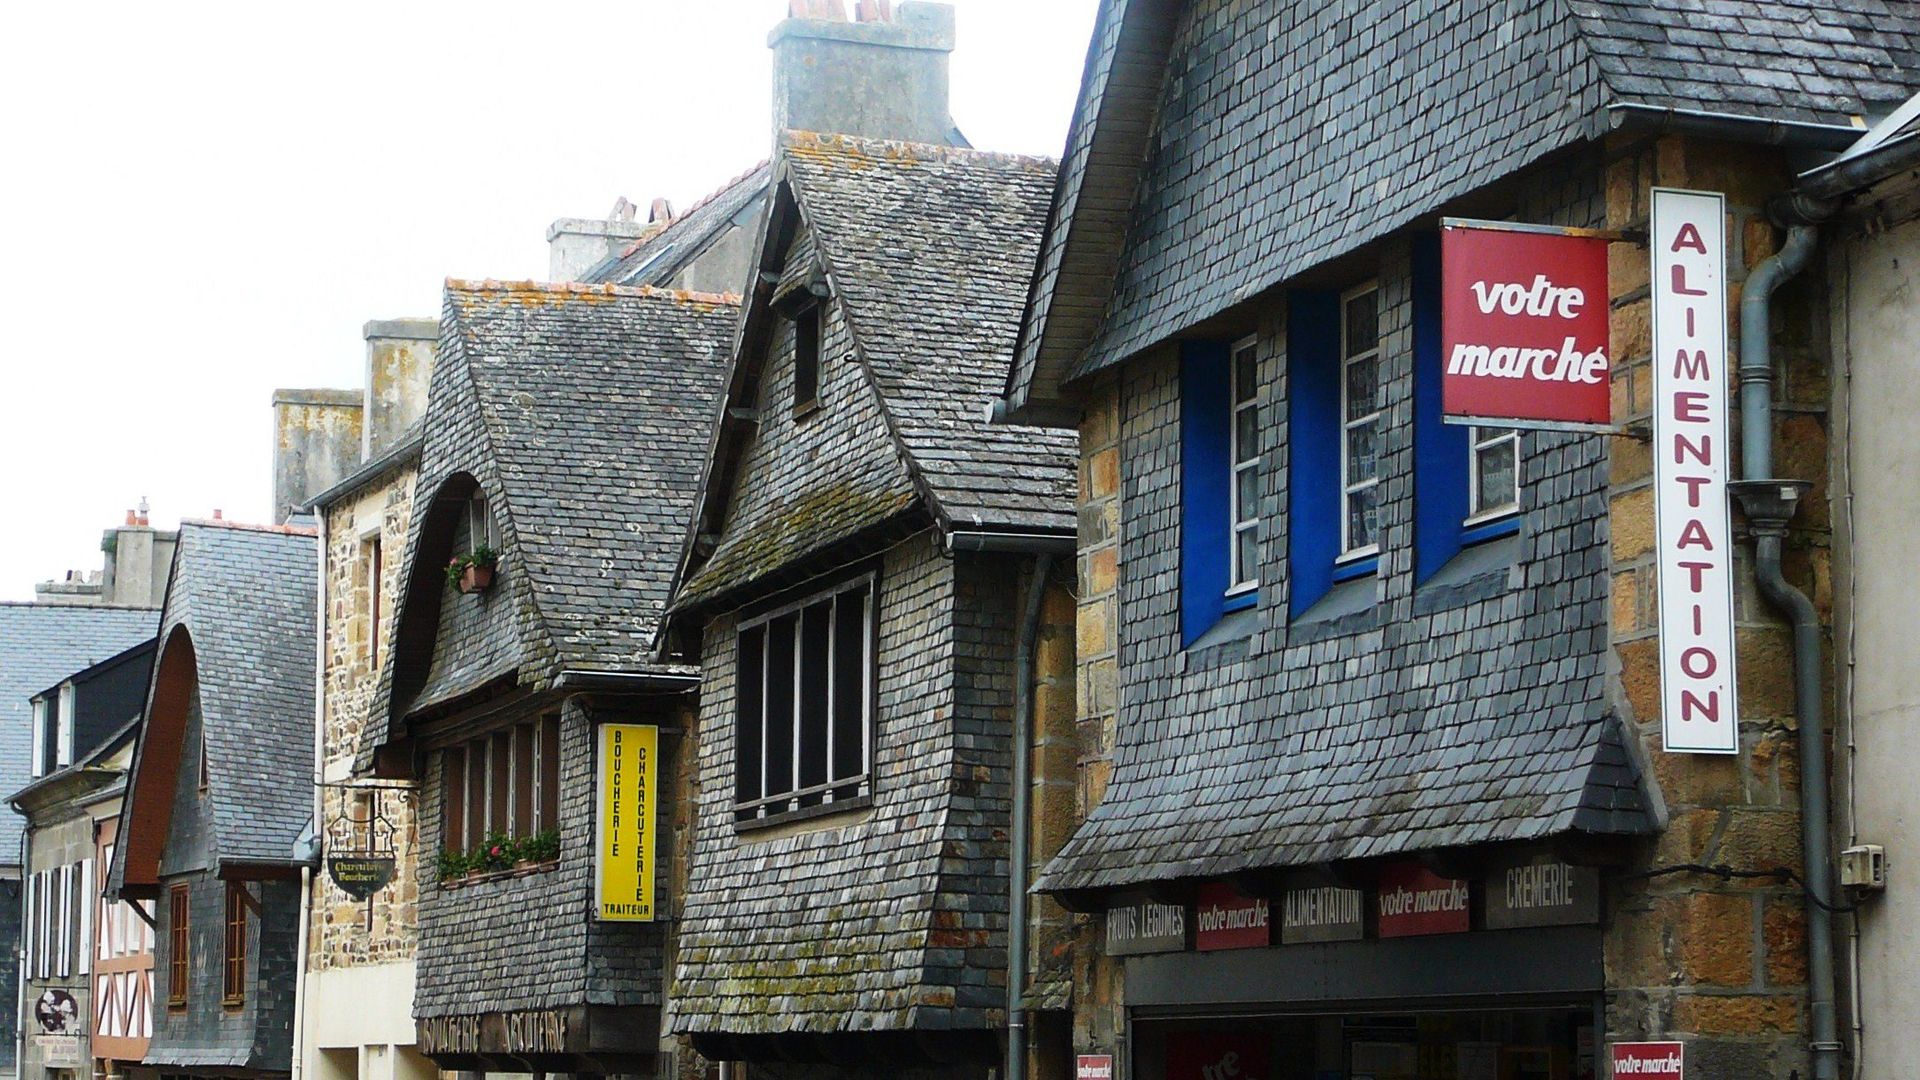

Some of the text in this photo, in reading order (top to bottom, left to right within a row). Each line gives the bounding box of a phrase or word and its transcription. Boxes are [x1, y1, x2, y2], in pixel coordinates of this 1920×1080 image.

[1470, 274, 1585, 320] votre
[1446, 336, 1609, 385] marché
[1670, 221, 1720, 724] ALIMENTATION
[612, 730, 622, 857] BOUCHERIE
[636, 747, 646, 902] CHARCUTERIE
[604, 903, 650, 915] TRAITEUR
[1199, 903, 1227, 933] votre
[1284, 886, 1362, 928] ALIMENTATION
[1380, 885, 1413, 917] votre
[1106, 905, 1137, 942] FRUITS
[1614, 1051, 1681, 1074] votre marché
